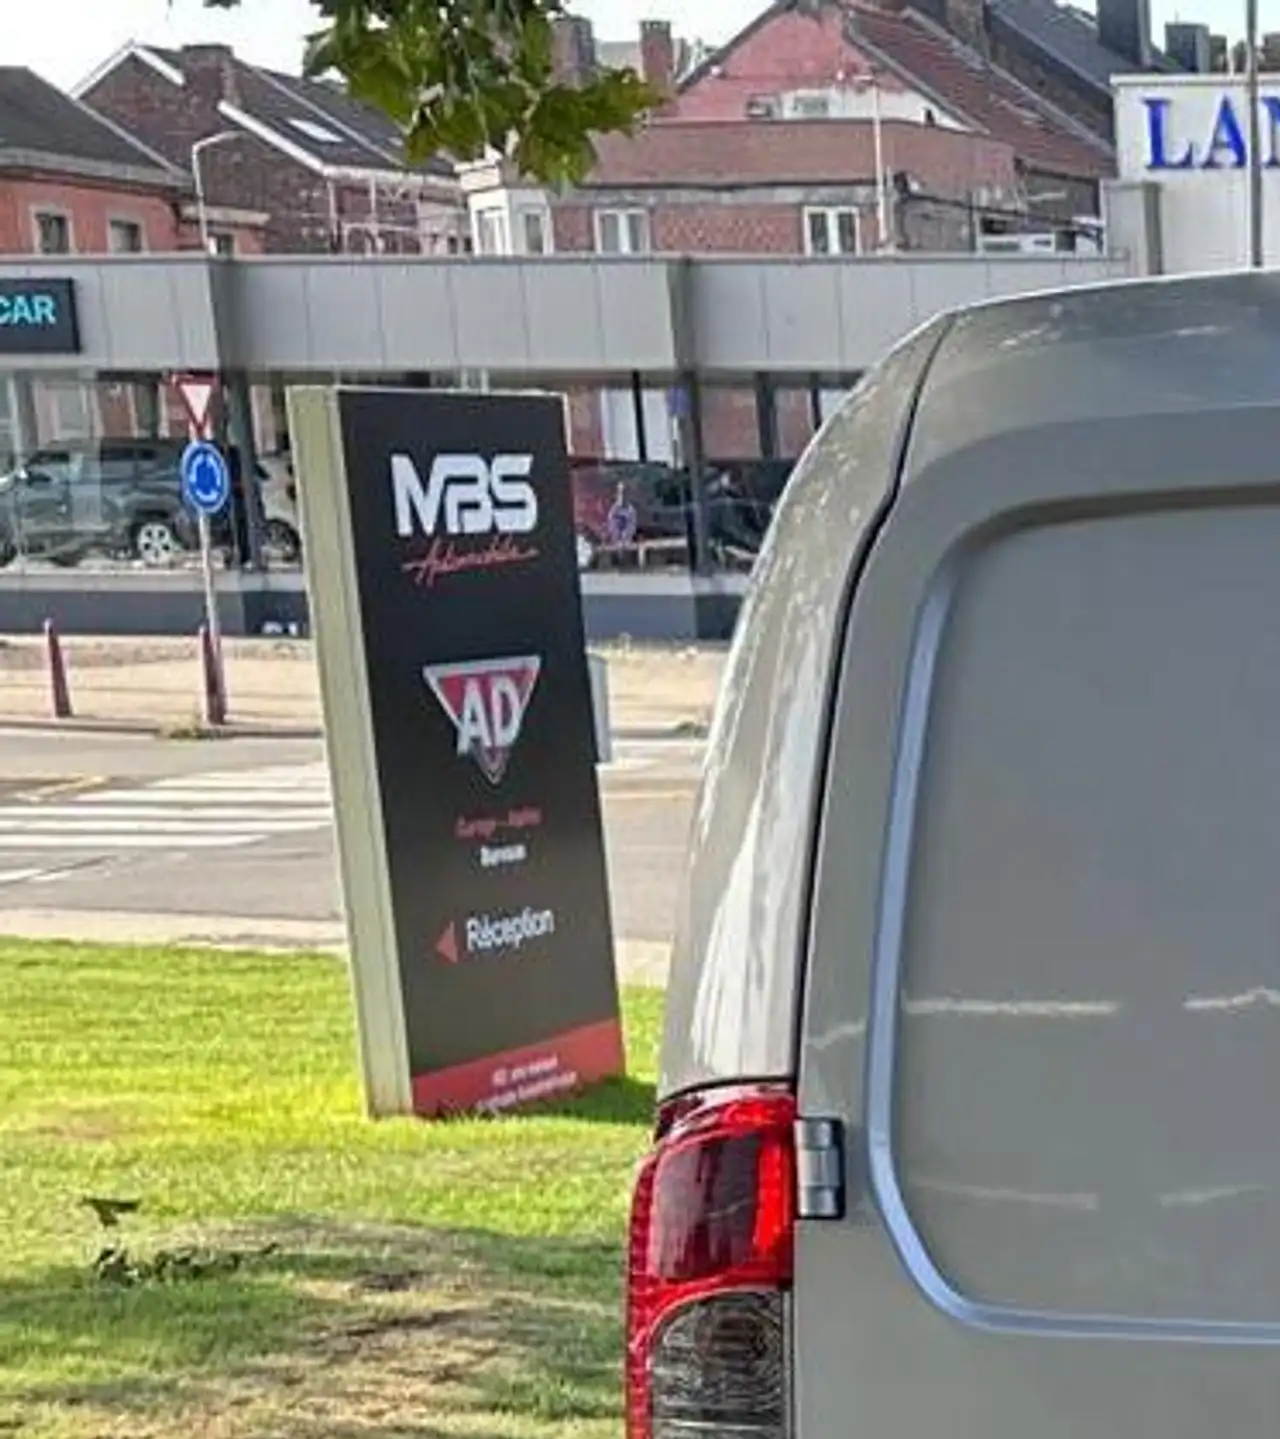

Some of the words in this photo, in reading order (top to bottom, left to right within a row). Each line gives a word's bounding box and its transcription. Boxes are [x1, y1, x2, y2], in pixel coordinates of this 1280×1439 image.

[390, 451, 539, 536] MBS
[457, 675, 523, 756] AD
[466, 905, 556, 952] Réception
